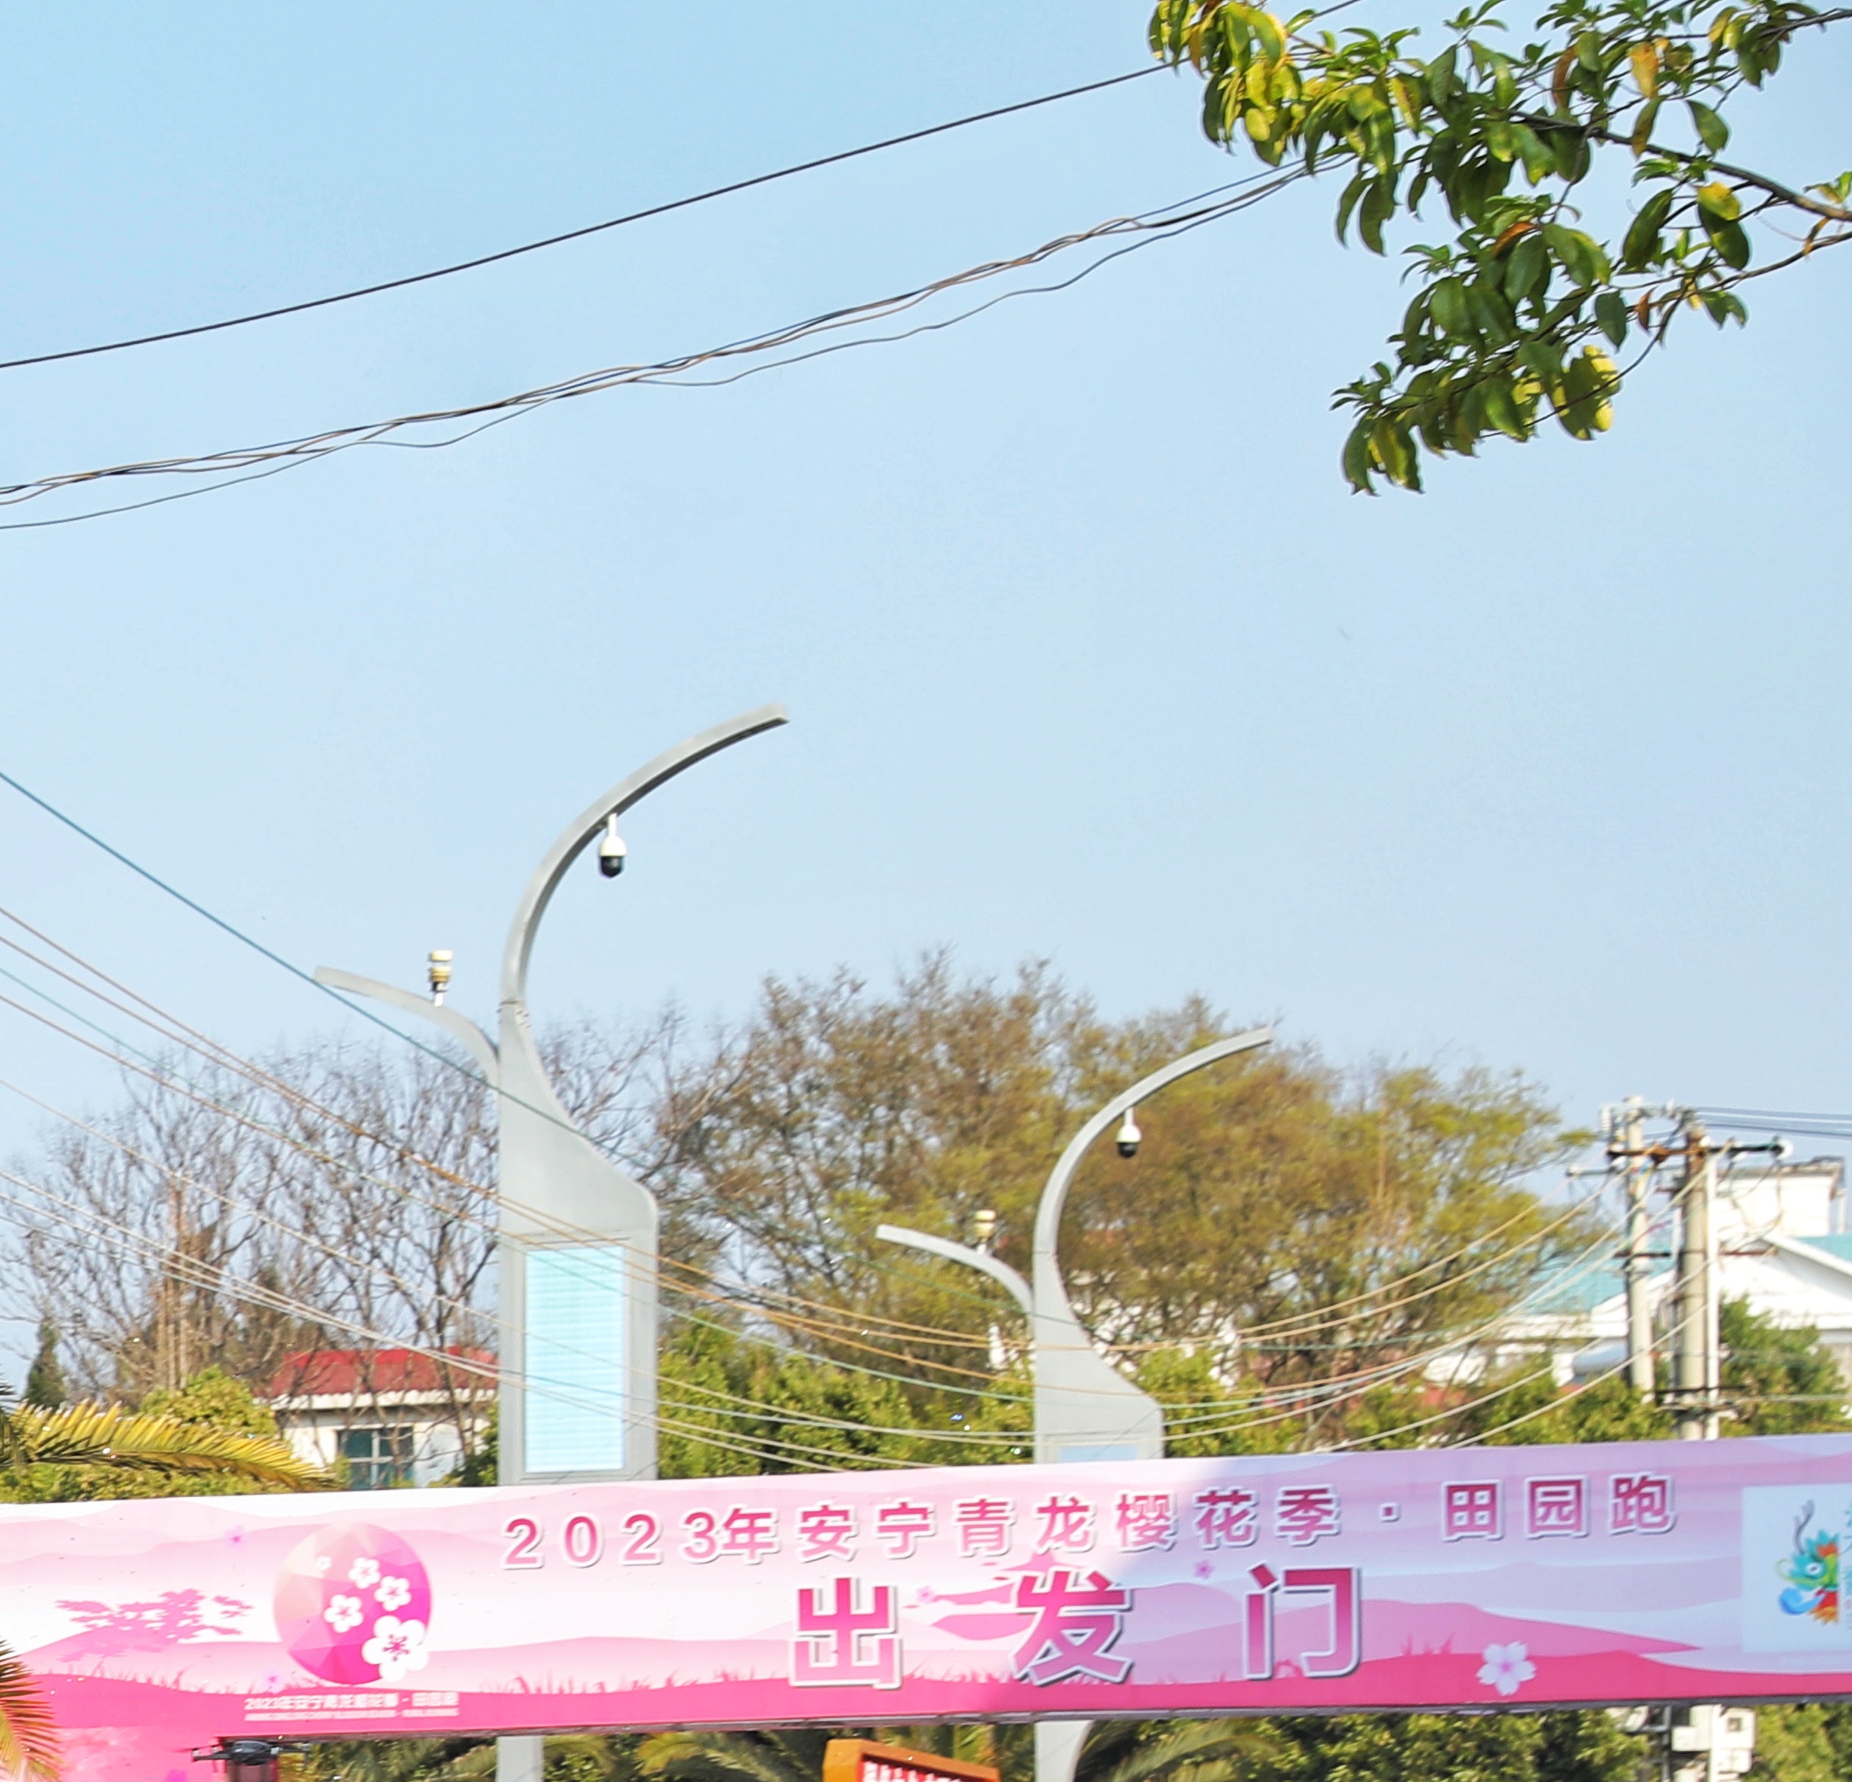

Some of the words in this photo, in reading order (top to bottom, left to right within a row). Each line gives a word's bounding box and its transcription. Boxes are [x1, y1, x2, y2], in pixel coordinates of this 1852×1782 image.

[504, 1472, 1675, 1570] 2023年安宁青龙樱花季·田园跑
[793, 1563, 1362, 1690] 出发门
